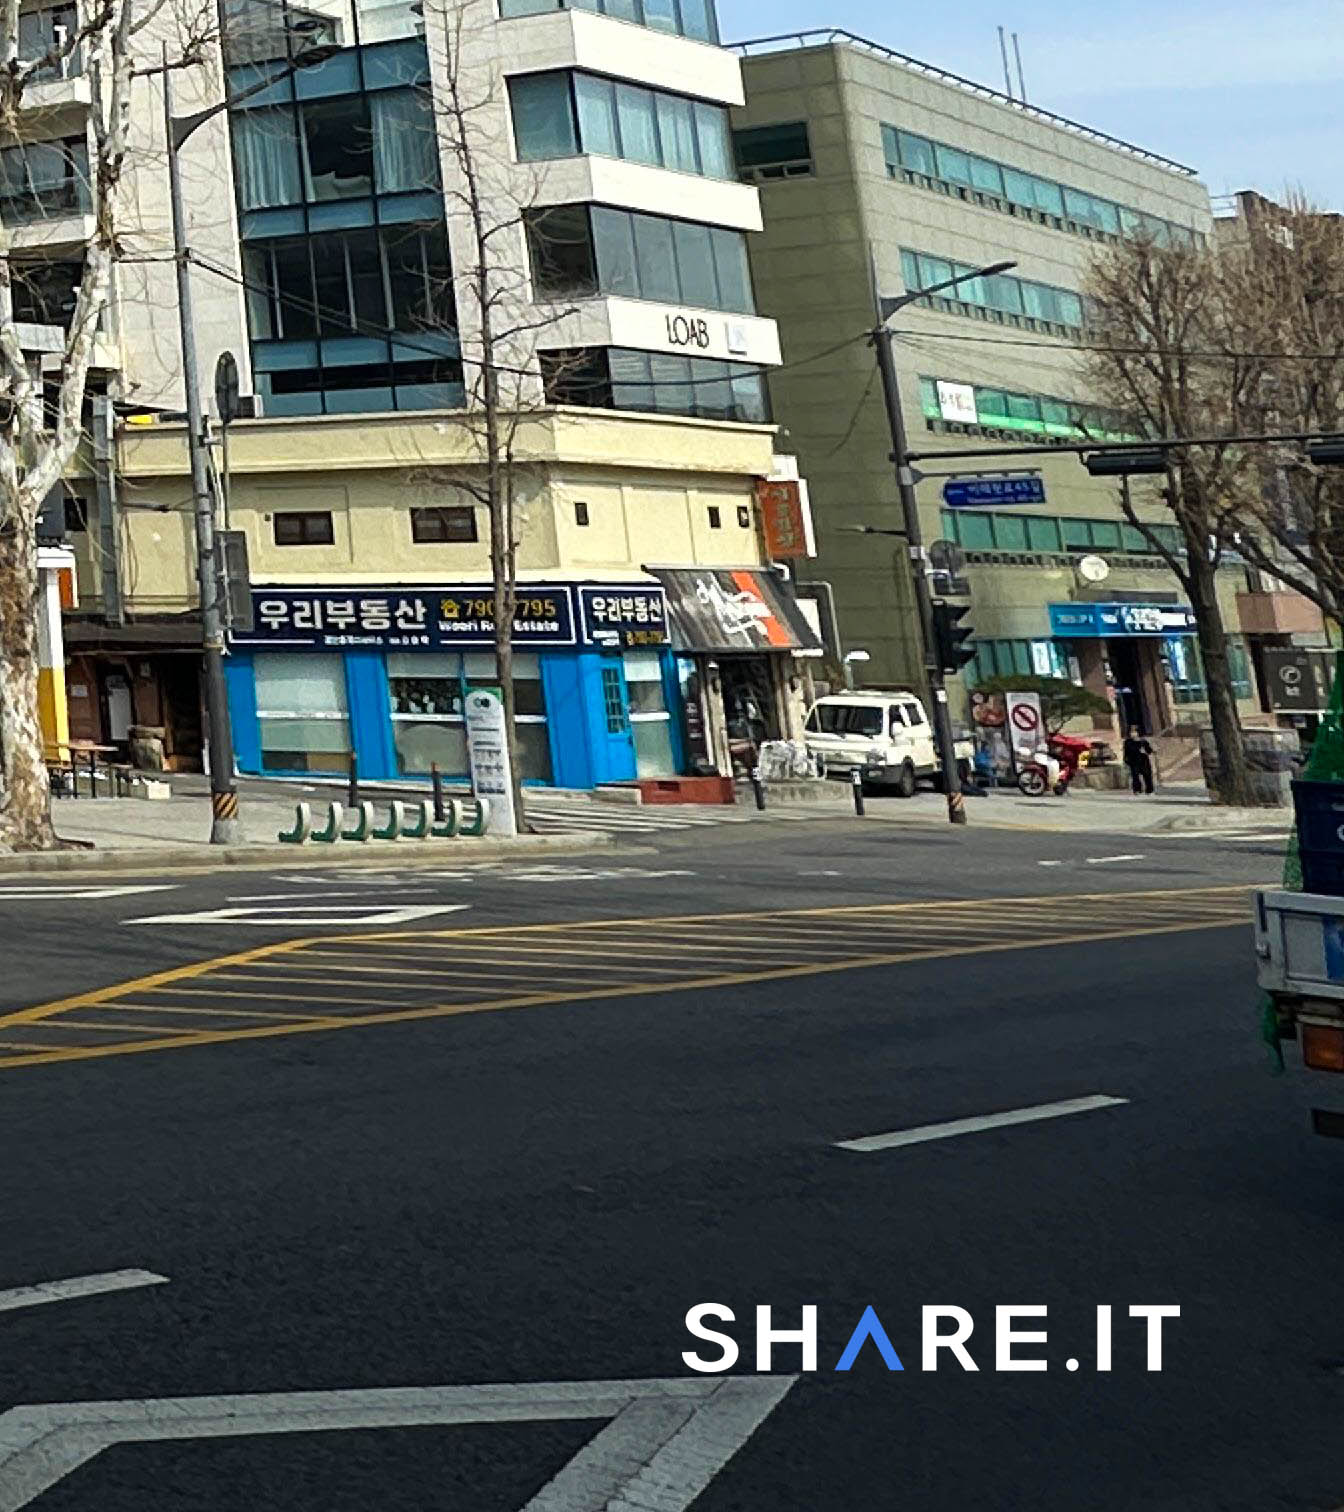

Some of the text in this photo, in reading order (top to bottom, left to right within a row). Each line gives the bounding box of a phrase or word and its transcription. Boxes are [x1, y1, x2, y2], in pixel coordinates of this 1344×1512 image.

[664, 314, 710, 349] LOAB
[259, 598, 427, 630] 우리부동산
[592, 596, 663, 623] 우리부동산
